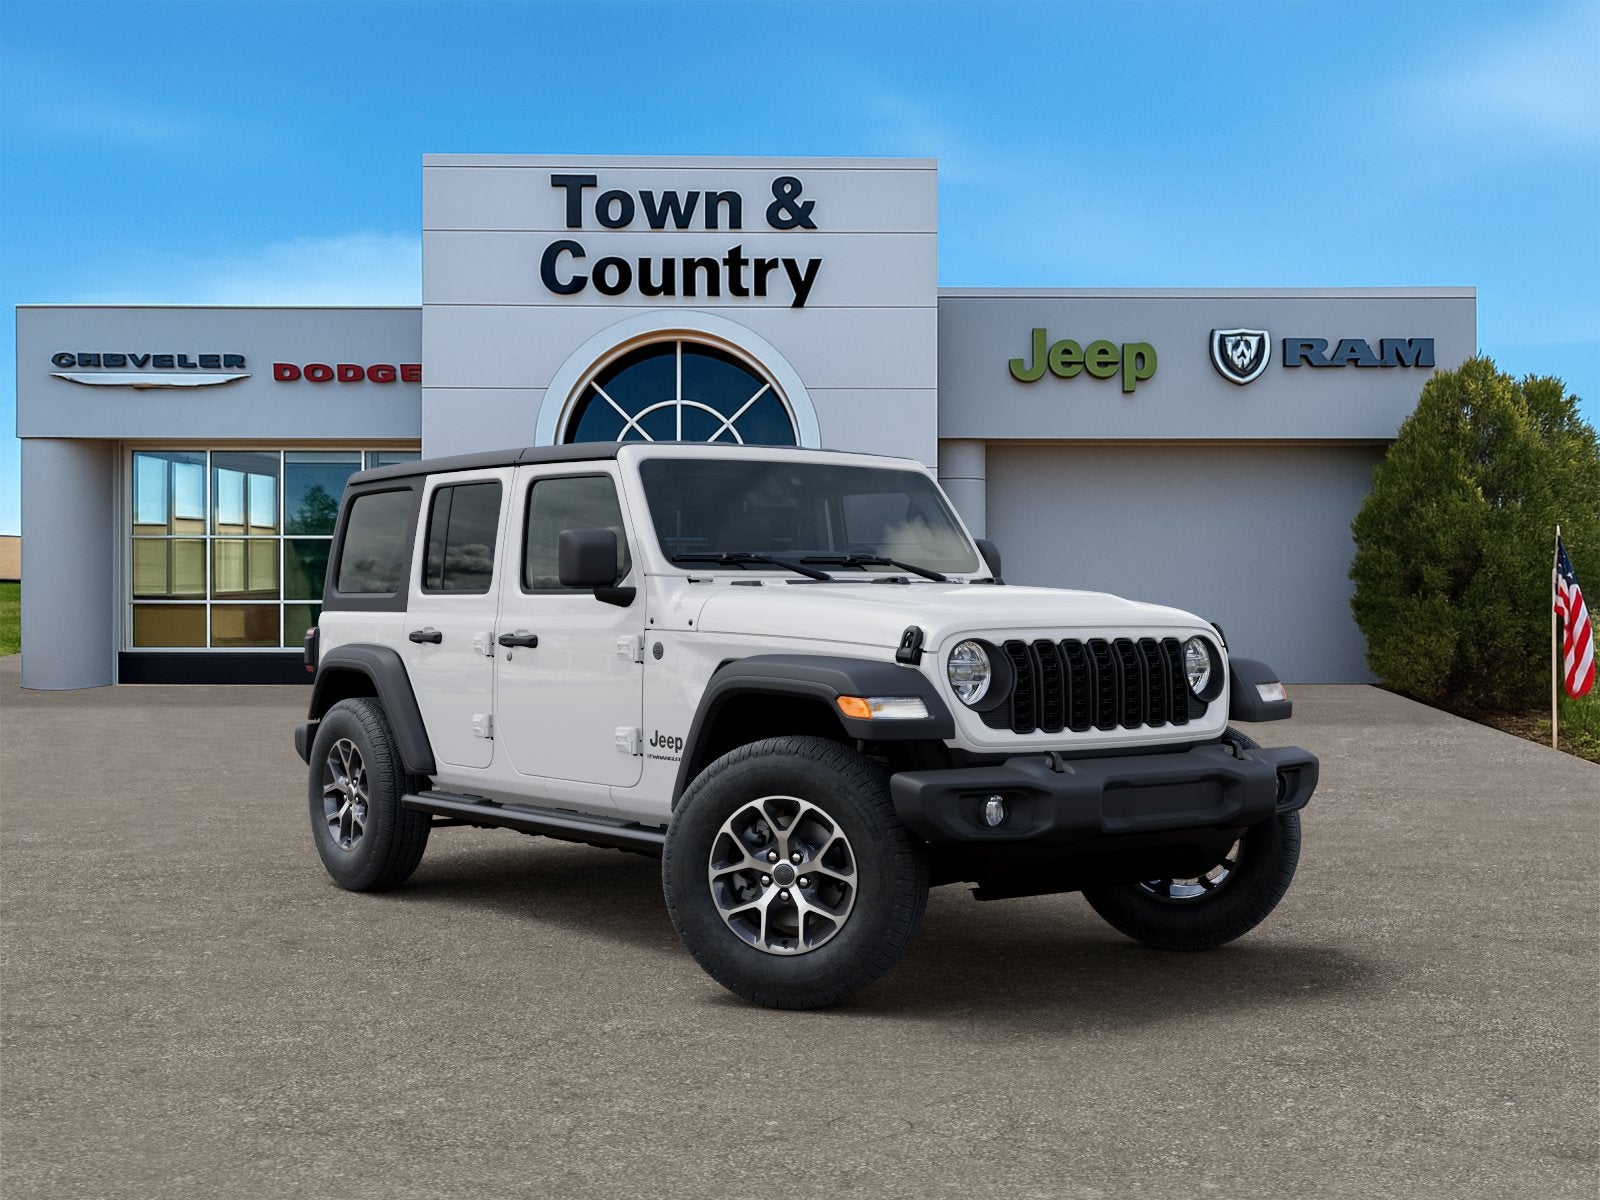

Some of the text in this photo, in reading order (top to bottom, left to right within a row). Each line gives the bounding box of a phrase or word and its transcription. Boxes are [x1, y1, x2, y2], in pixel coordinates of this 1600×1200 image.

[550, 174, 818, 230] Town &
[540, 239, 822, 308] Country
[273, 363, 422, 383] DODGE
[1009, 328, 1157, 393] Jeep
[1282, 337, 1435, 368] RAM
[649, 729, 683, 754] Jeep
